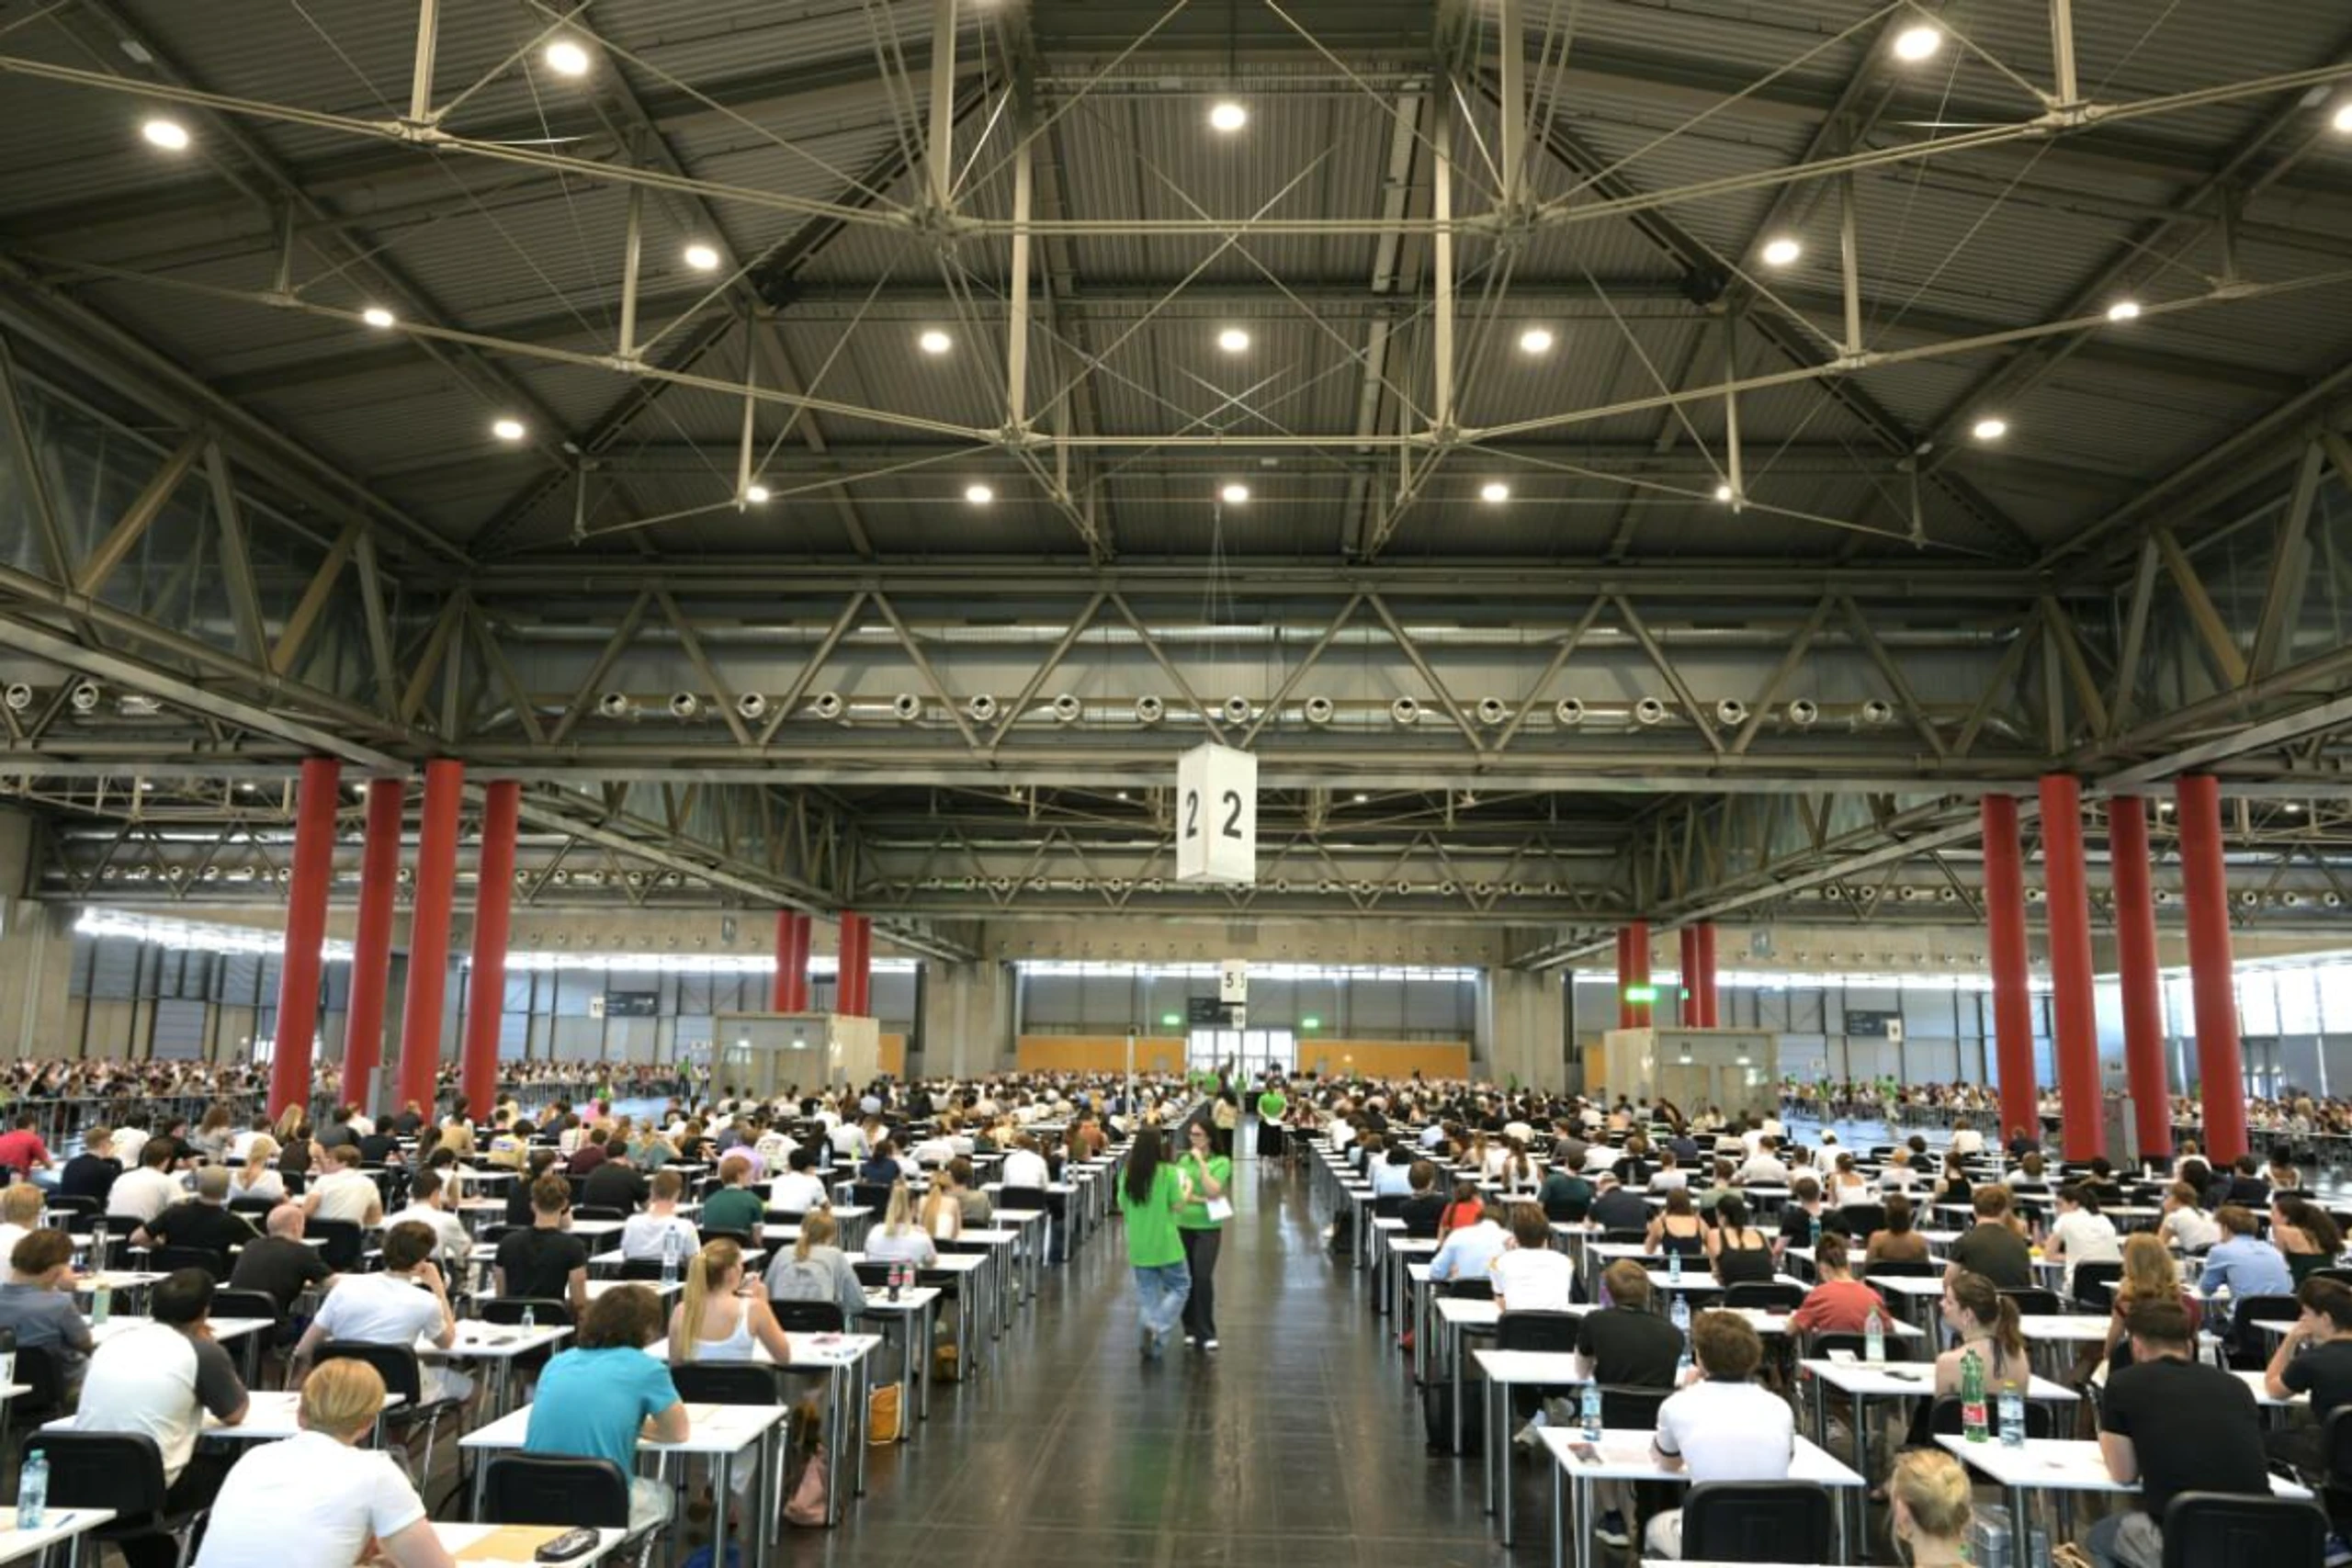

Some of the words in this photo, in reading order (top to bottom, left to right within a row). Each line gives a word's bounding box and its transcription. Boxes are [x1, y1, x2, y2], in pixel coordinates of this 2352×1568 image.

[1186, 790, 1198, 840] 2
[1223, 790, 1242, 840] 2
[1224, 972, 1234, 988] 5
